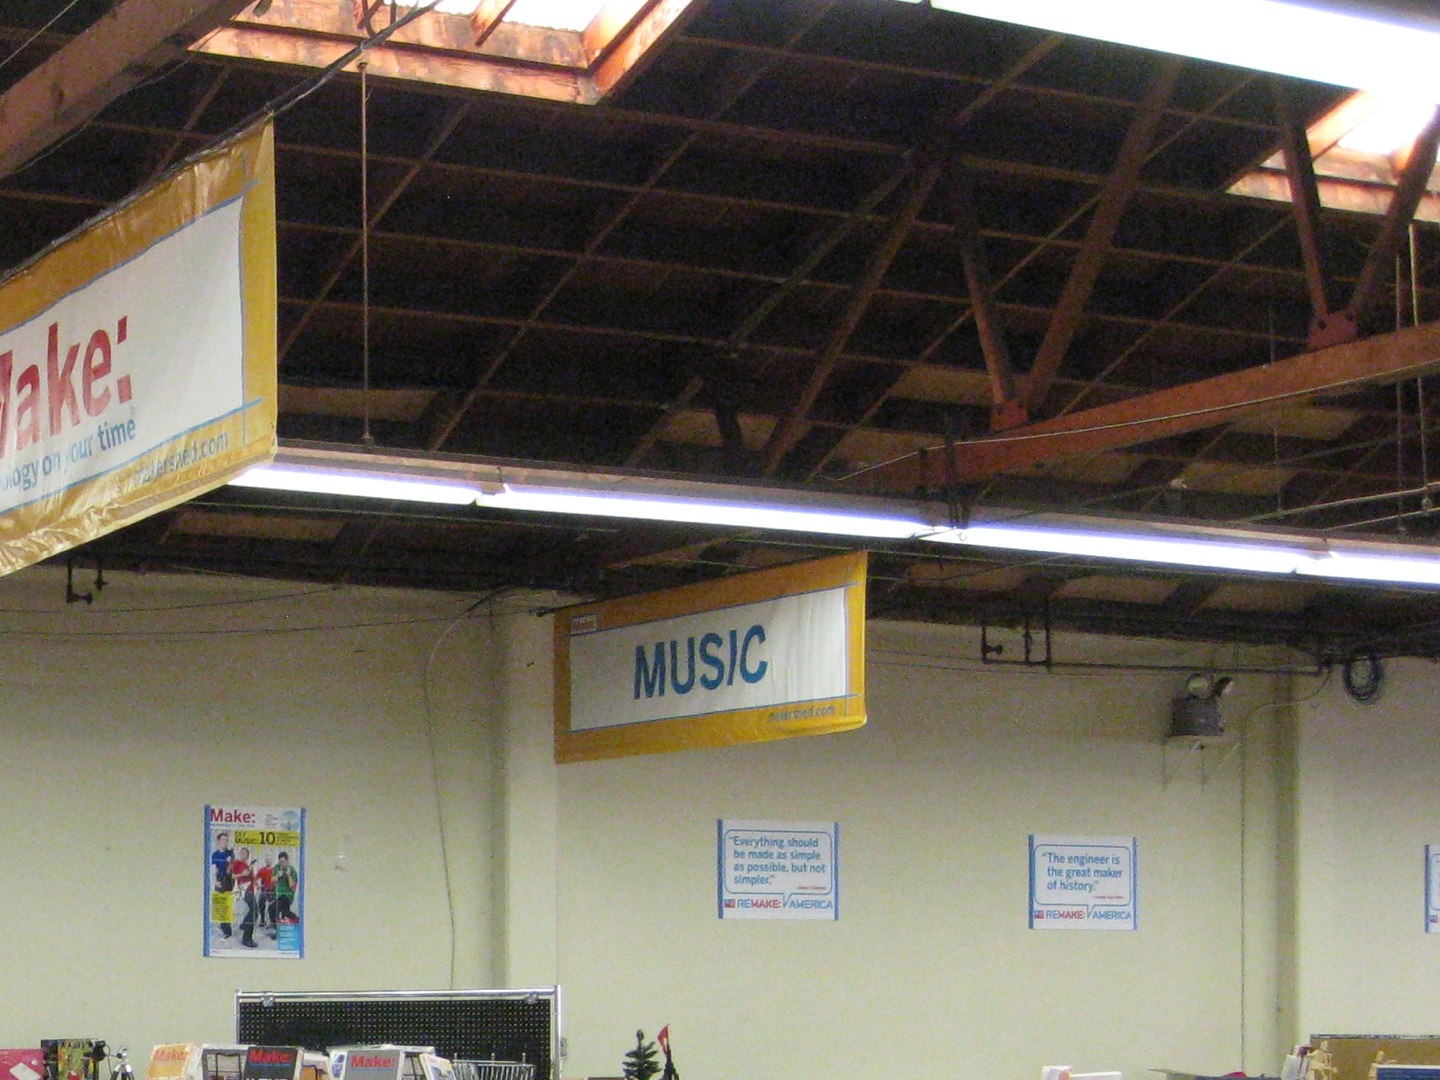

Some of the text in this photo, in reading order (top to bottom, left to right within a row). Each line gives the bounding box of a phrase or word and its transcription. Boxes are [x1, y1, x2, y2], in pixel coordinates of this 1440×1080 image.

[42, 454, 60, 477] on
[97, 419, 136, 452] time
[634, 624, 768, 700] MUSIC
[211, 808, 257, 824] Make:
[259, 831, 276, 846] 10
[787, 837, 819, 848] should
[733, 850, 821, 862] be made as simple
[1067, 854, 1109, 867] engineer
[1111, 854, 1121, 865] is
[733, 863, 745, 872] as
[791, 863, 808, 873] but
[809, 863, 826, 874] not
[1047, 866, 1123, 880] the great maker
[1047, 880, 1057, 891] of
[788, 899, 834, 909] AMERICA
[1092, 910, 1133, 920] AMERICA
[350, 1055, 396, 1068] Make:
